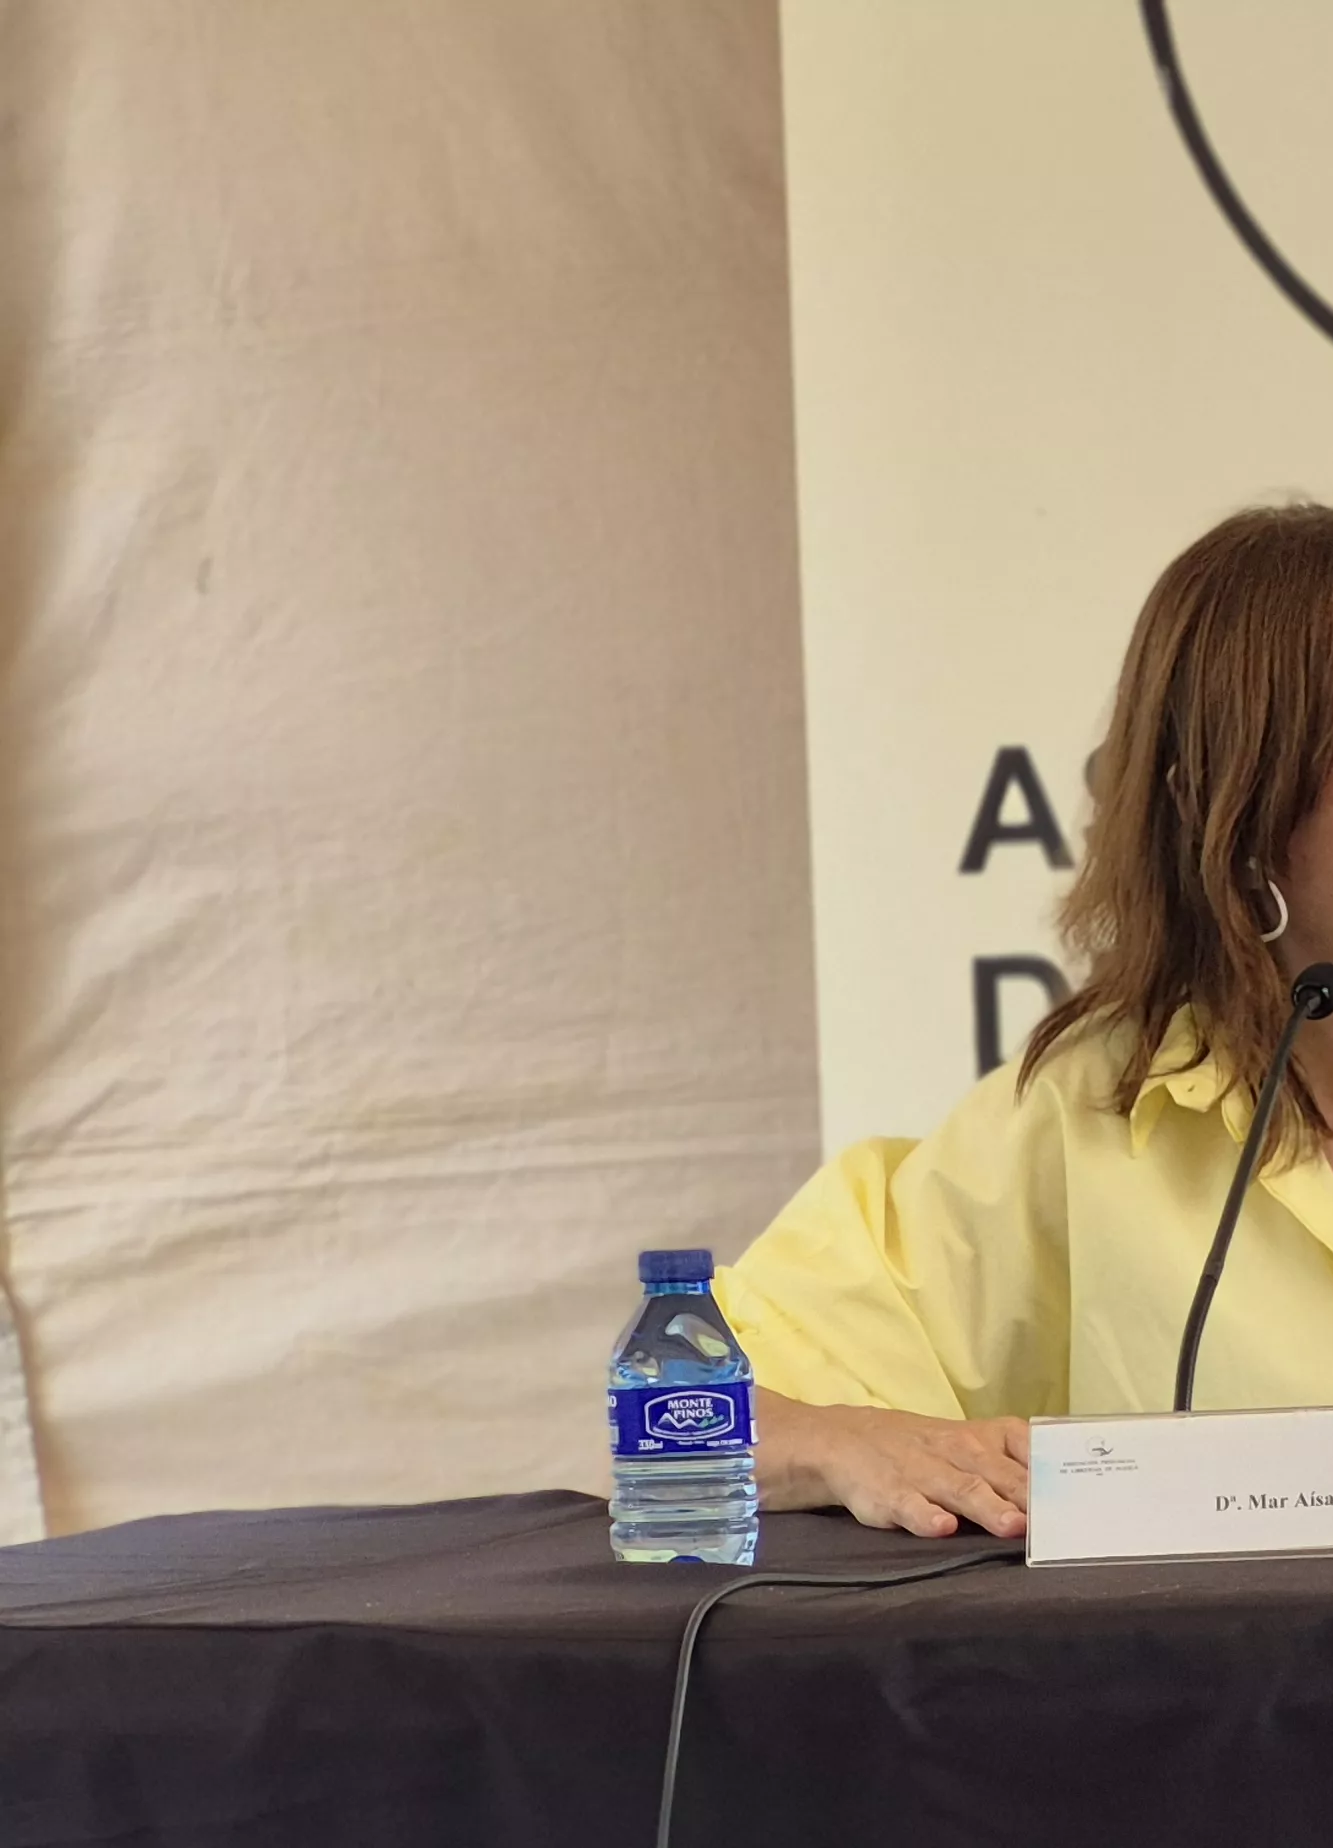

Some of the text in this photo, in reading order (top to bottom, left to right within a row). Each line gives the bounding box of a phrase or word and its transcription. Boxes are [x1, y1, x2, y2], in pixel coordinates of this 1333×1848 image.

[667, 1398, 714, 1410] MONTE
[673, 1408, 714, 1420] PINOS
[1248, 1493, 1289, 1510] Mar
